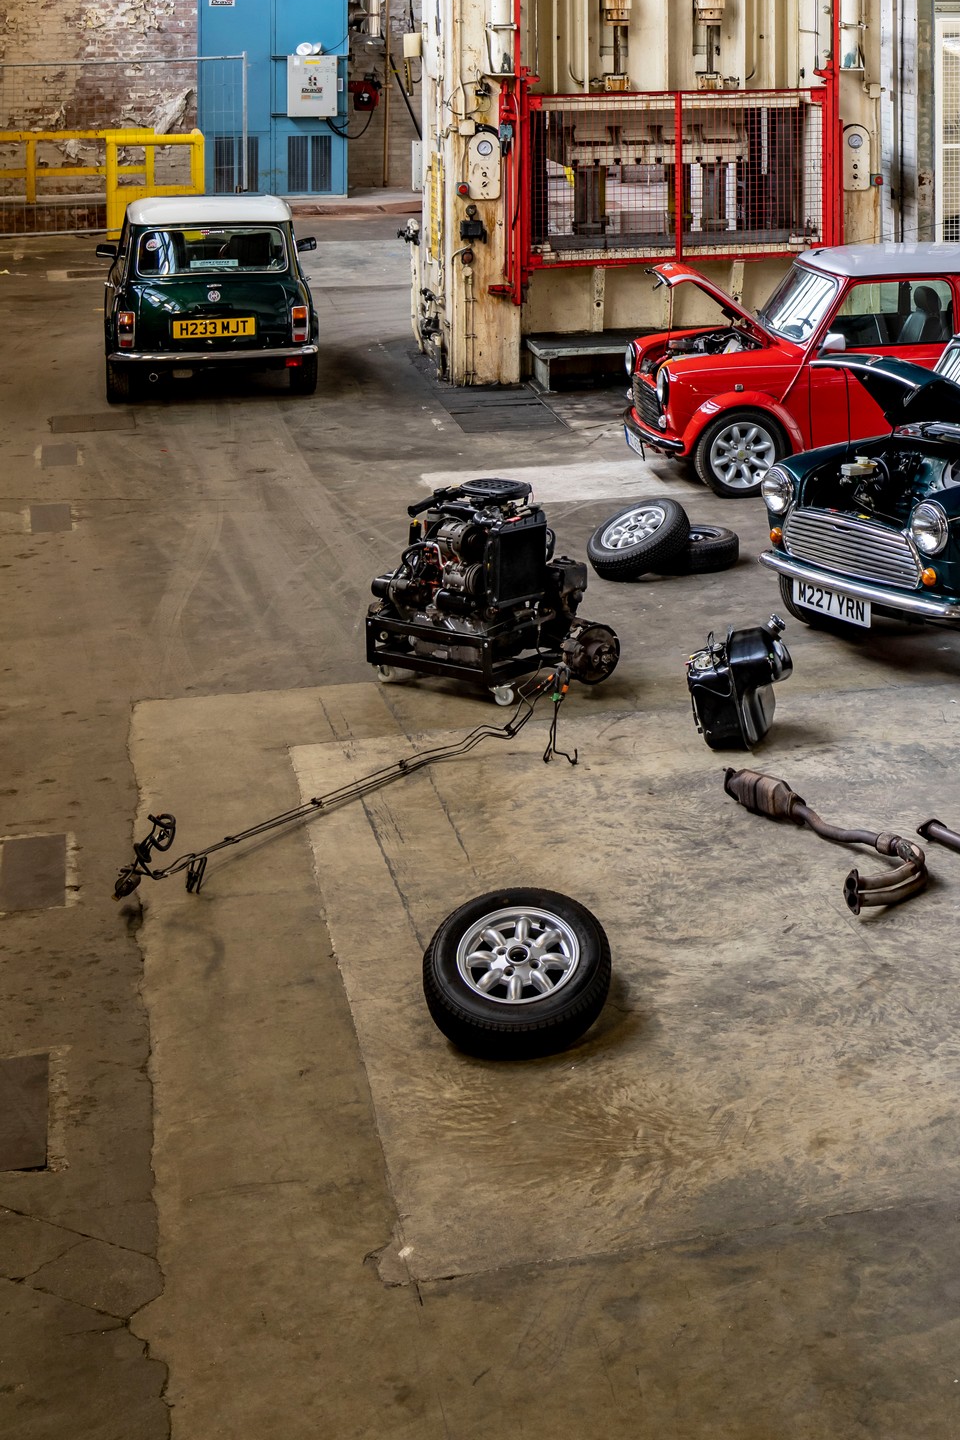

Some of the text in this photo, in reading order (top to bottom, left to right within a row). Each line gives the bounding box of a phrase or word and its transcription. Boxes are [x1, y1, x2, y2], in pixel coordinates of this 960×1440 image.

[180, 320, 248, 335] H233 MJT
[798, 581, 865, 622] M227 YRN
